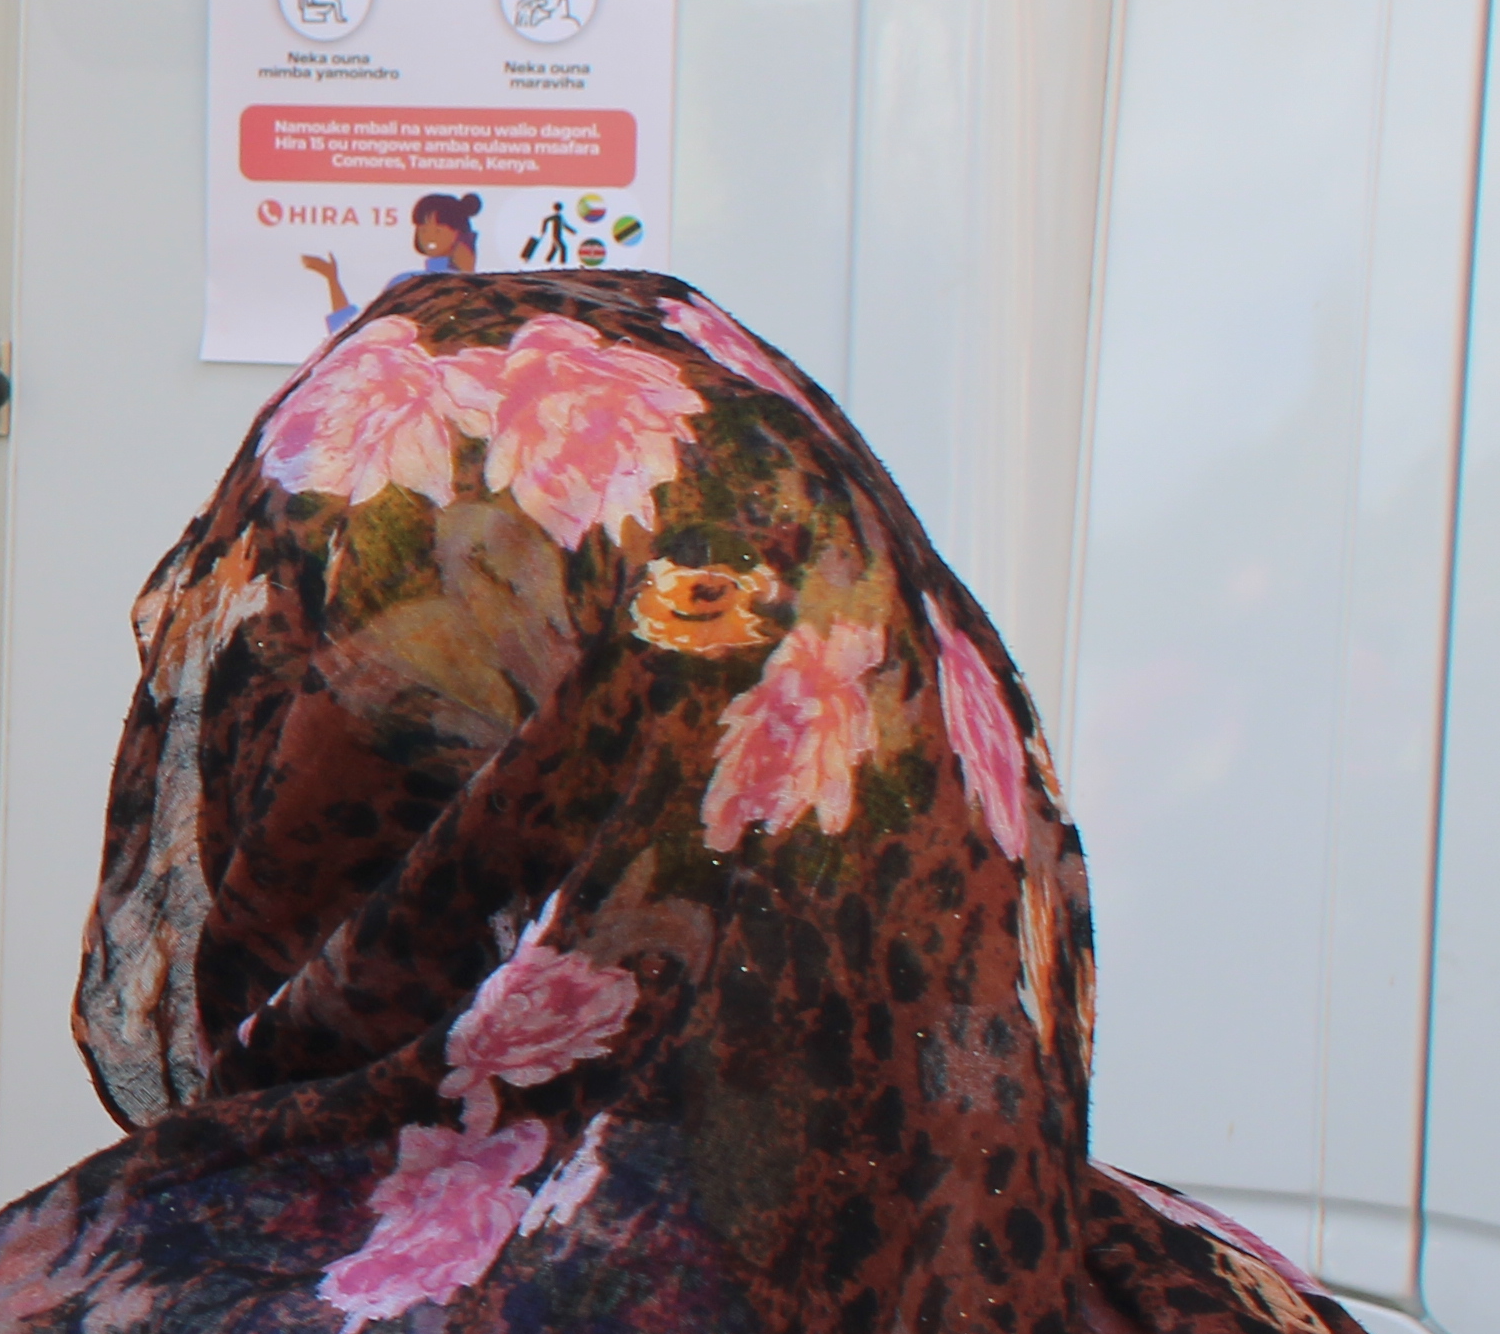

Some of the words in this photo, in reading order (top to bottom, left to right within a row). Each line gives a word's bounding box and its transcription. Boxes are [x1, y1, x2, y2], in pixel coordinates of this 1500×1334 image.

[287, 51, 326, 65] Neka
[330, 54, 370, 65] ouna
[258, 66, 311, 80] mimba
[504, 61, 547, 75] Neka
[551, 62, 590, 75] ouna
[274, 120, 352, 136] Namouke
[402, 124, 421, 136] na
[274, 138, 307, 151] Hira
[310, 137, 324, 151] 15
[328, 140, 348, 151] ou
[424, 140, 471, 154] amba
[473, 140, 532, 155] oulawa
[535, 140, 599, 156] msafara
[332, 154, 406, 171] Comores,
[409, 156, 483, 173] Tanzanie,
[486, 157, 539, 173] Kenya.
[288, 207, 359, 226] HIRA
[371, 208, 399, 227] 15
